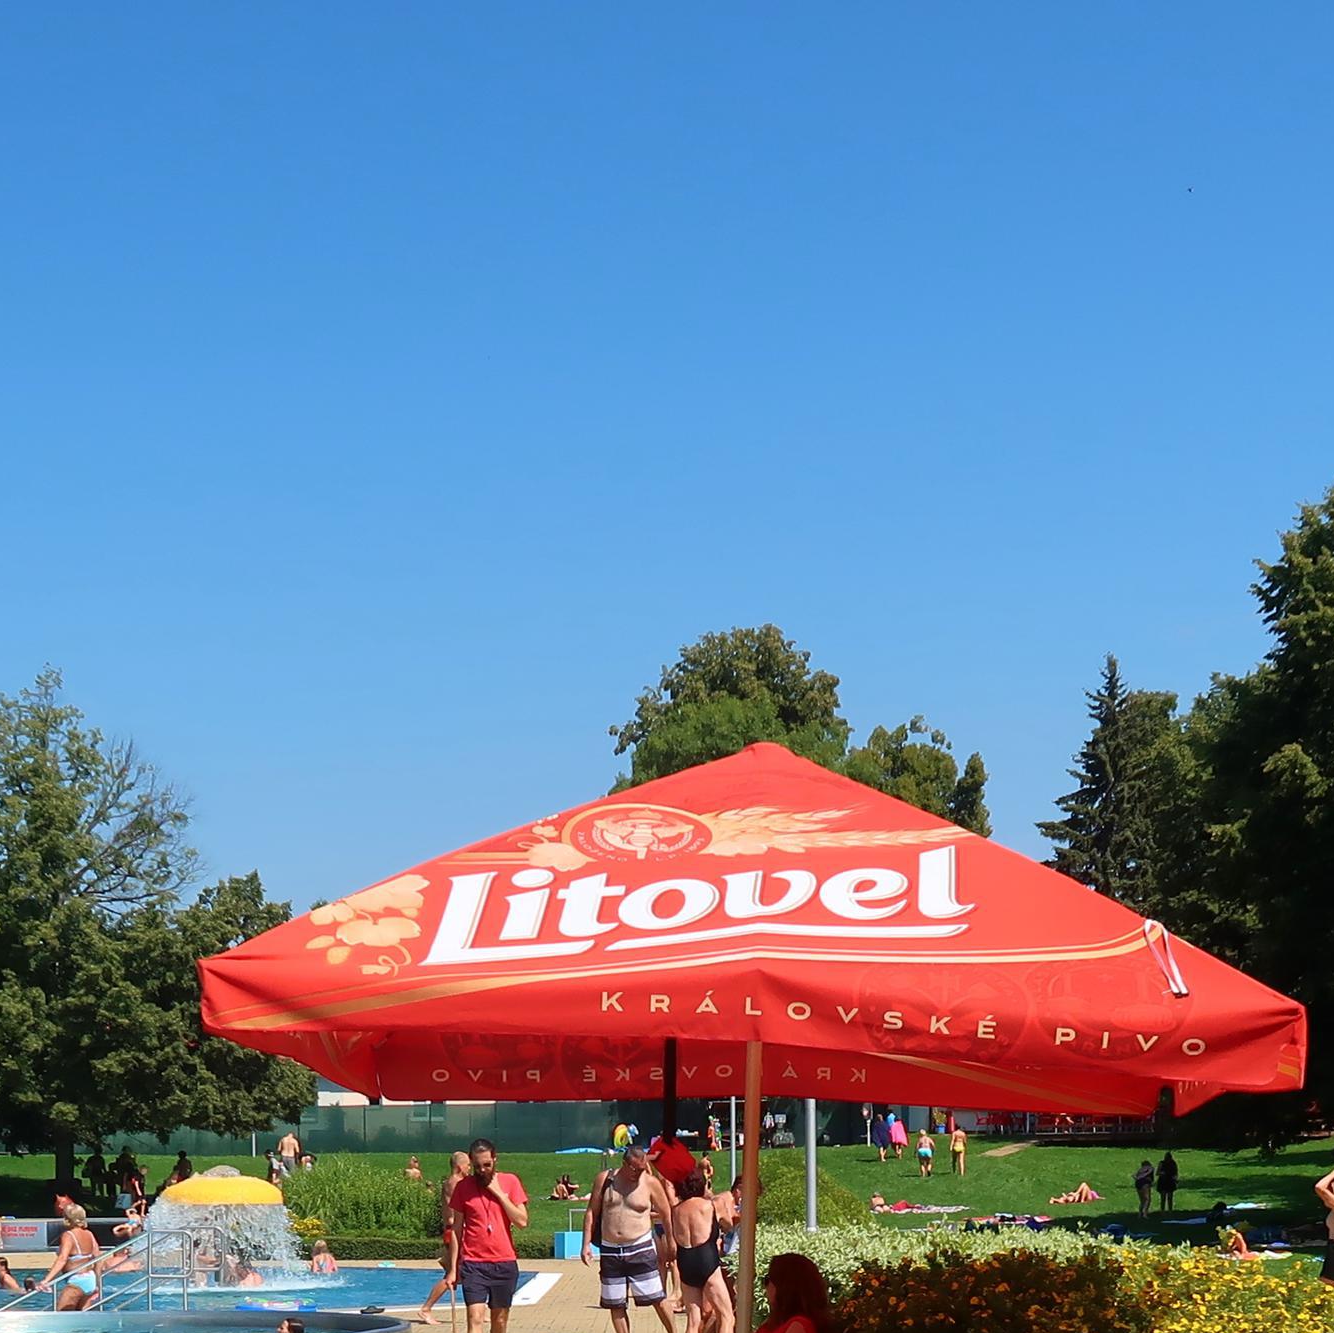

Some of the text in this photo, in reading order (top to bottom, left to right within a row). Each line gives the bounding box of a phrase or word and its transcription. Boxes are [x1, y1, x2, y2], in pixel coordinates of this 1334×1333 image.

[418, 844, 977, 967] Litovel
[599, 989, 998, 1040] KRÁLOVSKÉ
[1054, 1027, 1207, 1057] PIVO
